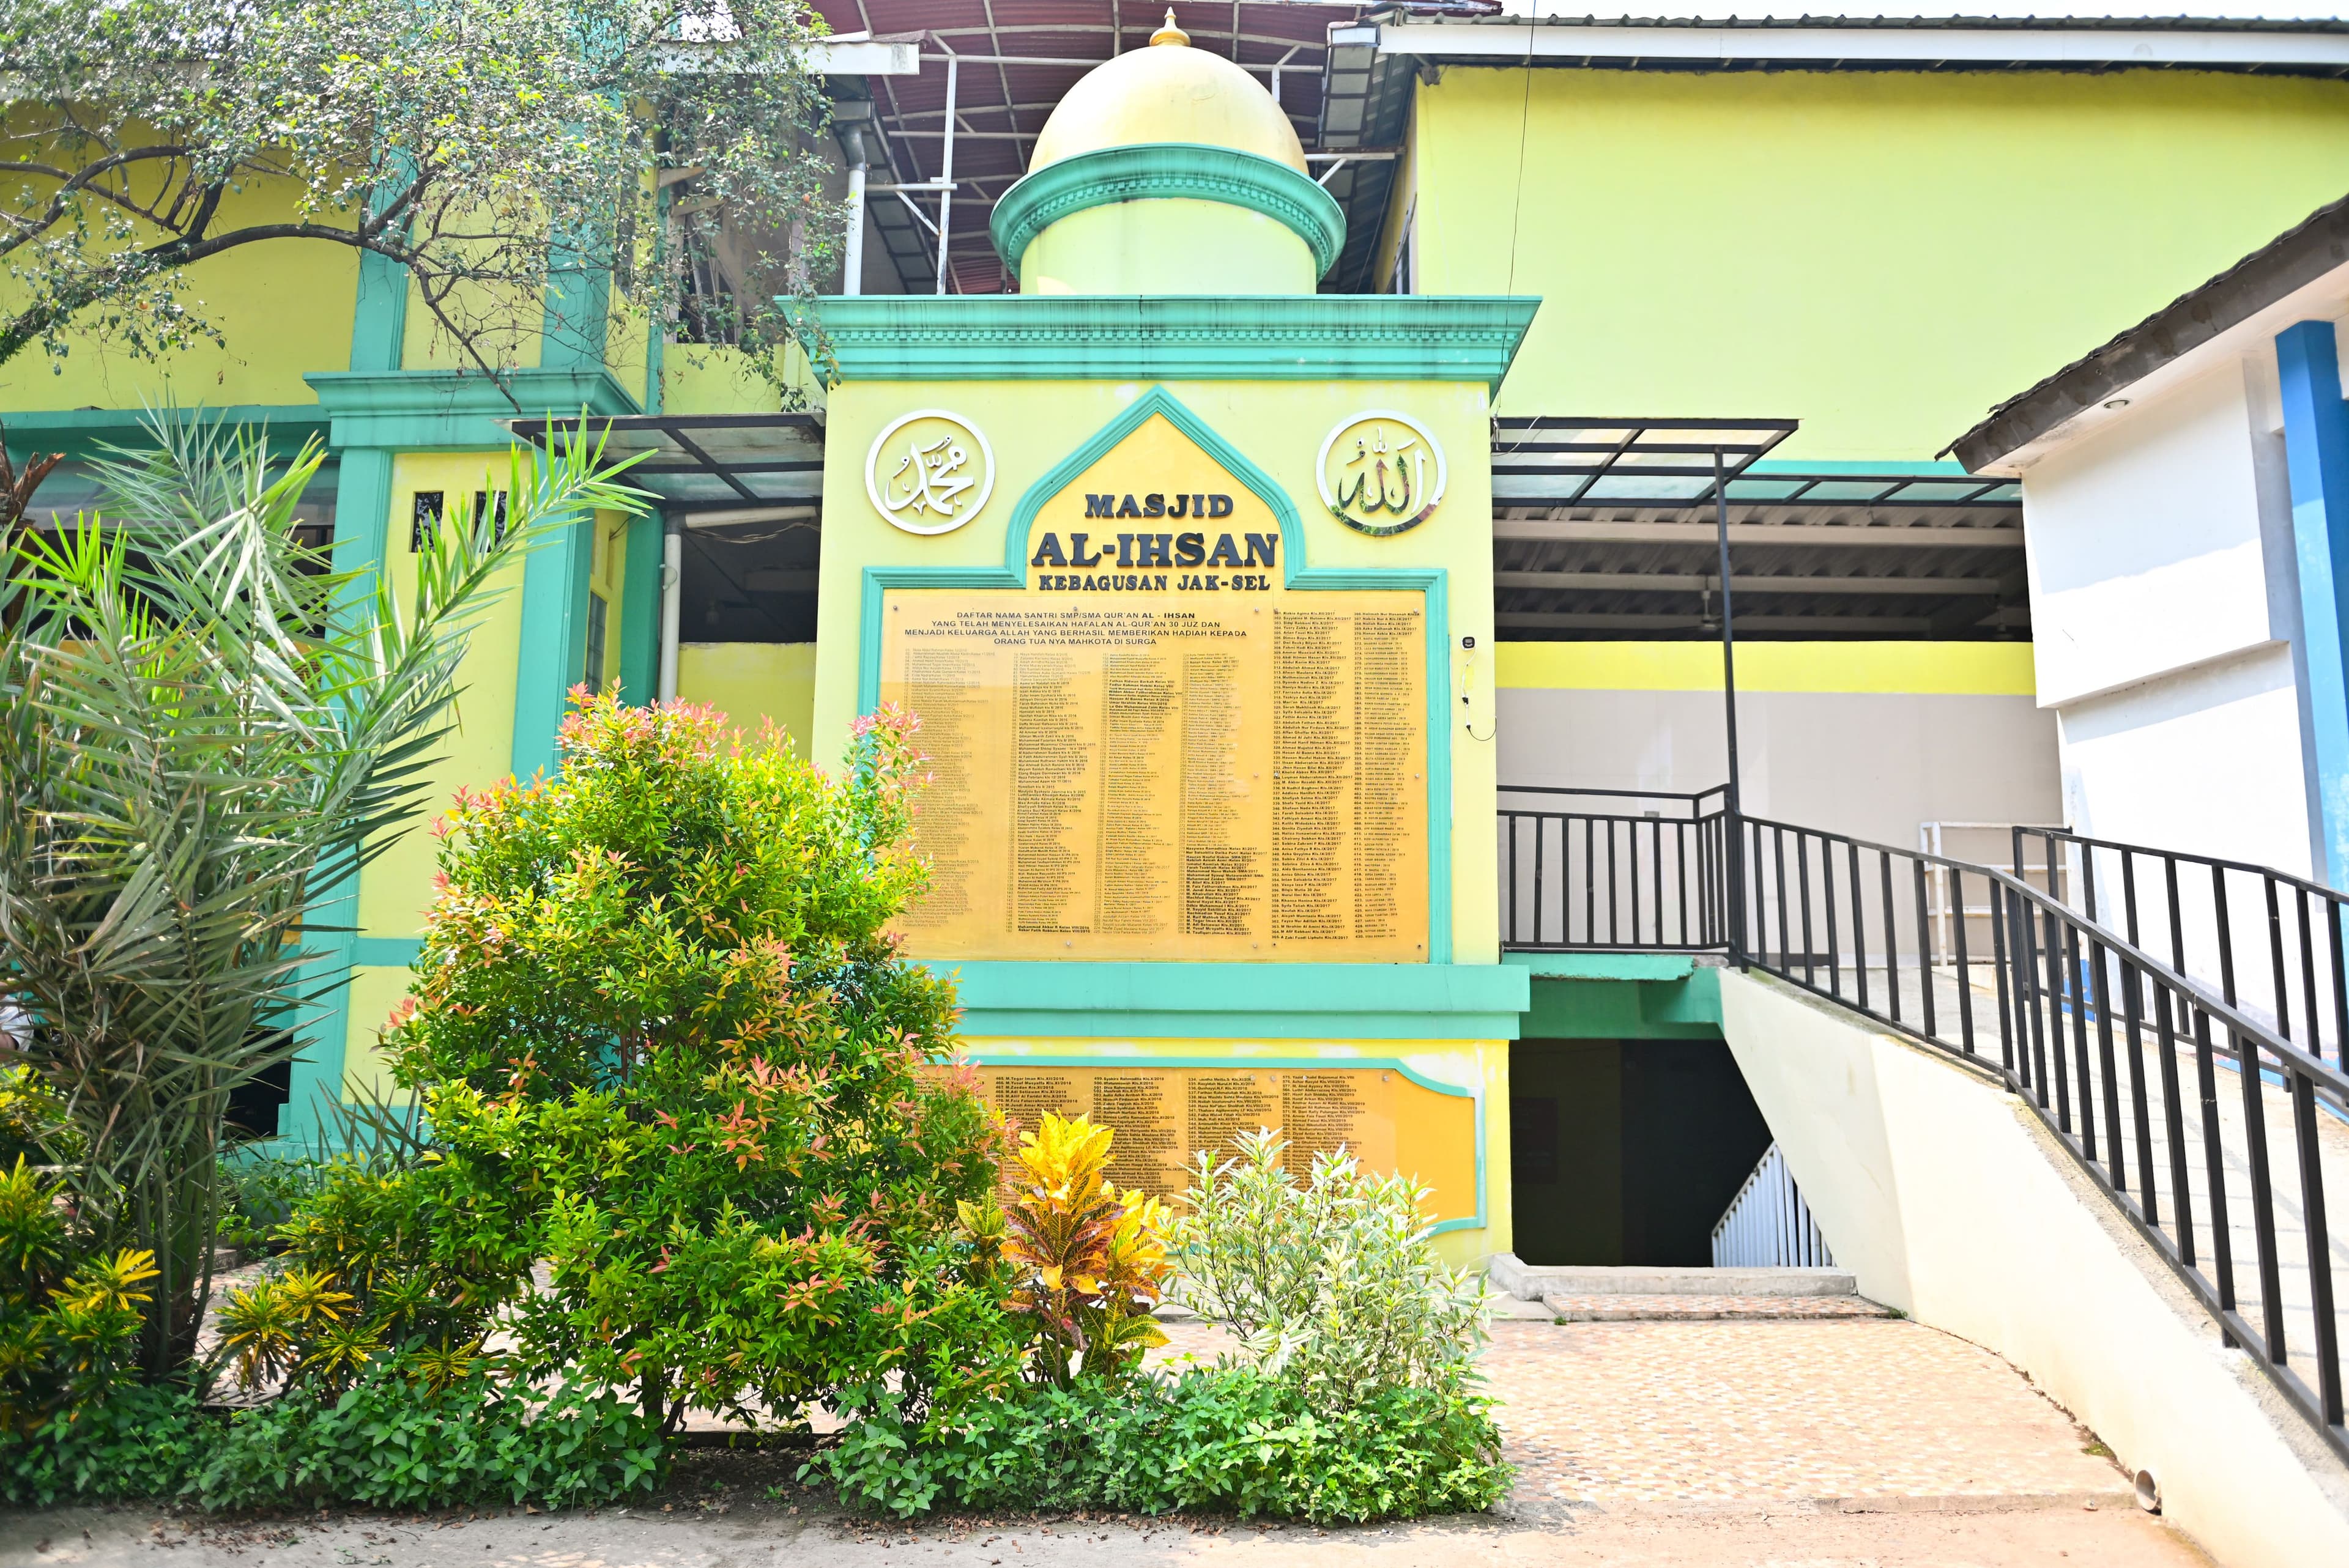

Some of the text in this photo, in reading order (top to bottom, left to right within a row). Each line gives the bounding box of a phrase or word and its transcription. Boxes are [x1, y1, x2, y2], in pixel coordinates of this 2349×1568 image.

[1085, 494, 1233, 519] MASJID
[1031, 532, 1278, 568] AL-IHSAN
[1039, 575, 1270, 591] KEBAGUSAN JAK-SEL
